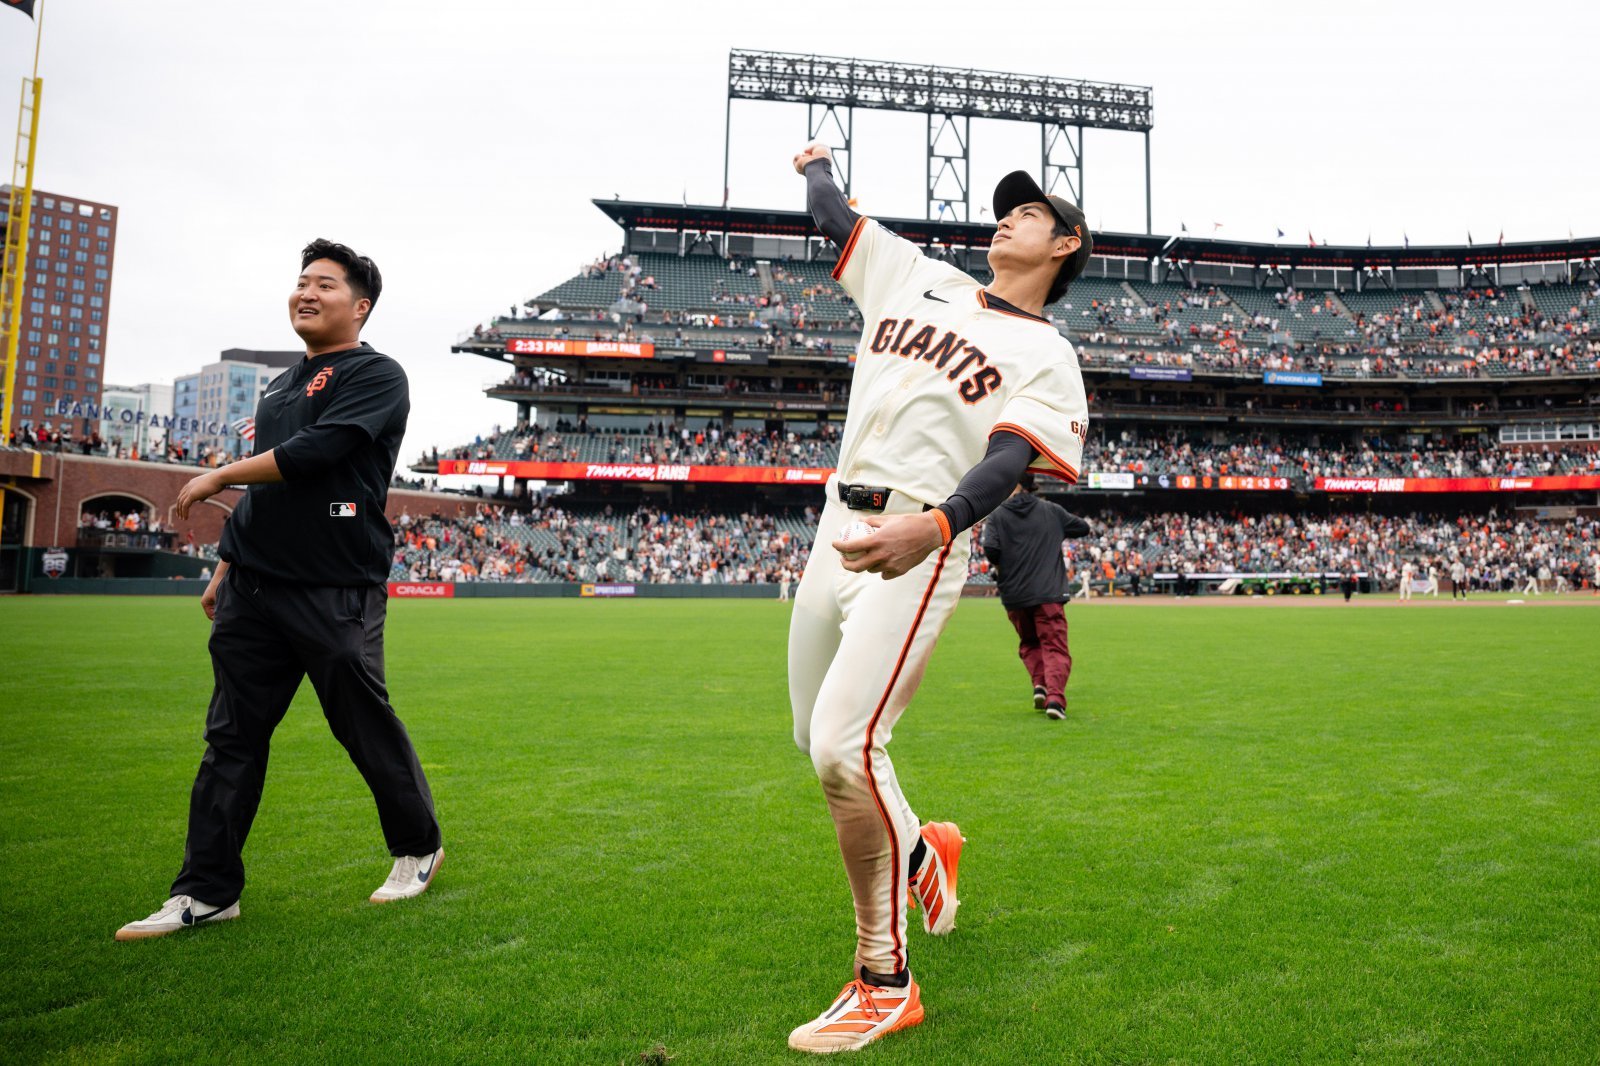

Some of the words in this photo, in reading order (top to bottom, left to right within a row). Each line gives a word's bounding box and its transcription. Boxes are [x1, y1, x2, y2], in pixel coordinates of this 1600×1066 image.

[515, 340, 544, 352] 2:33
[545, 341, 566, 353] PM
[586, 342, 618, 354] ORACLE
[619, 343, 642, 356] PARK
[726, 353, 752, 361] TOYOTA
[869, 317, 1003, 405] GIANTS
[1303, 376, 1318, 384] LAW
[55, 400, 114, 421] BANK
[120, 409, 145, 425] OF
[149, 413, 229, 437] AMERICA
[468, 462, 488, 474] FAN
[586, 464, 628, 478] THANK
[656, 464, 691, 480] FANS!
[1181, 476, 1191, 488] 0
[1224, 476, 1233, 489] 4
[1324, 478, 1357, 491] THANK
[1378, 478, 1405, 492] FANS!
[873, 492, 882, 506] 51
[396, 585, 446, 596] ORACLE
